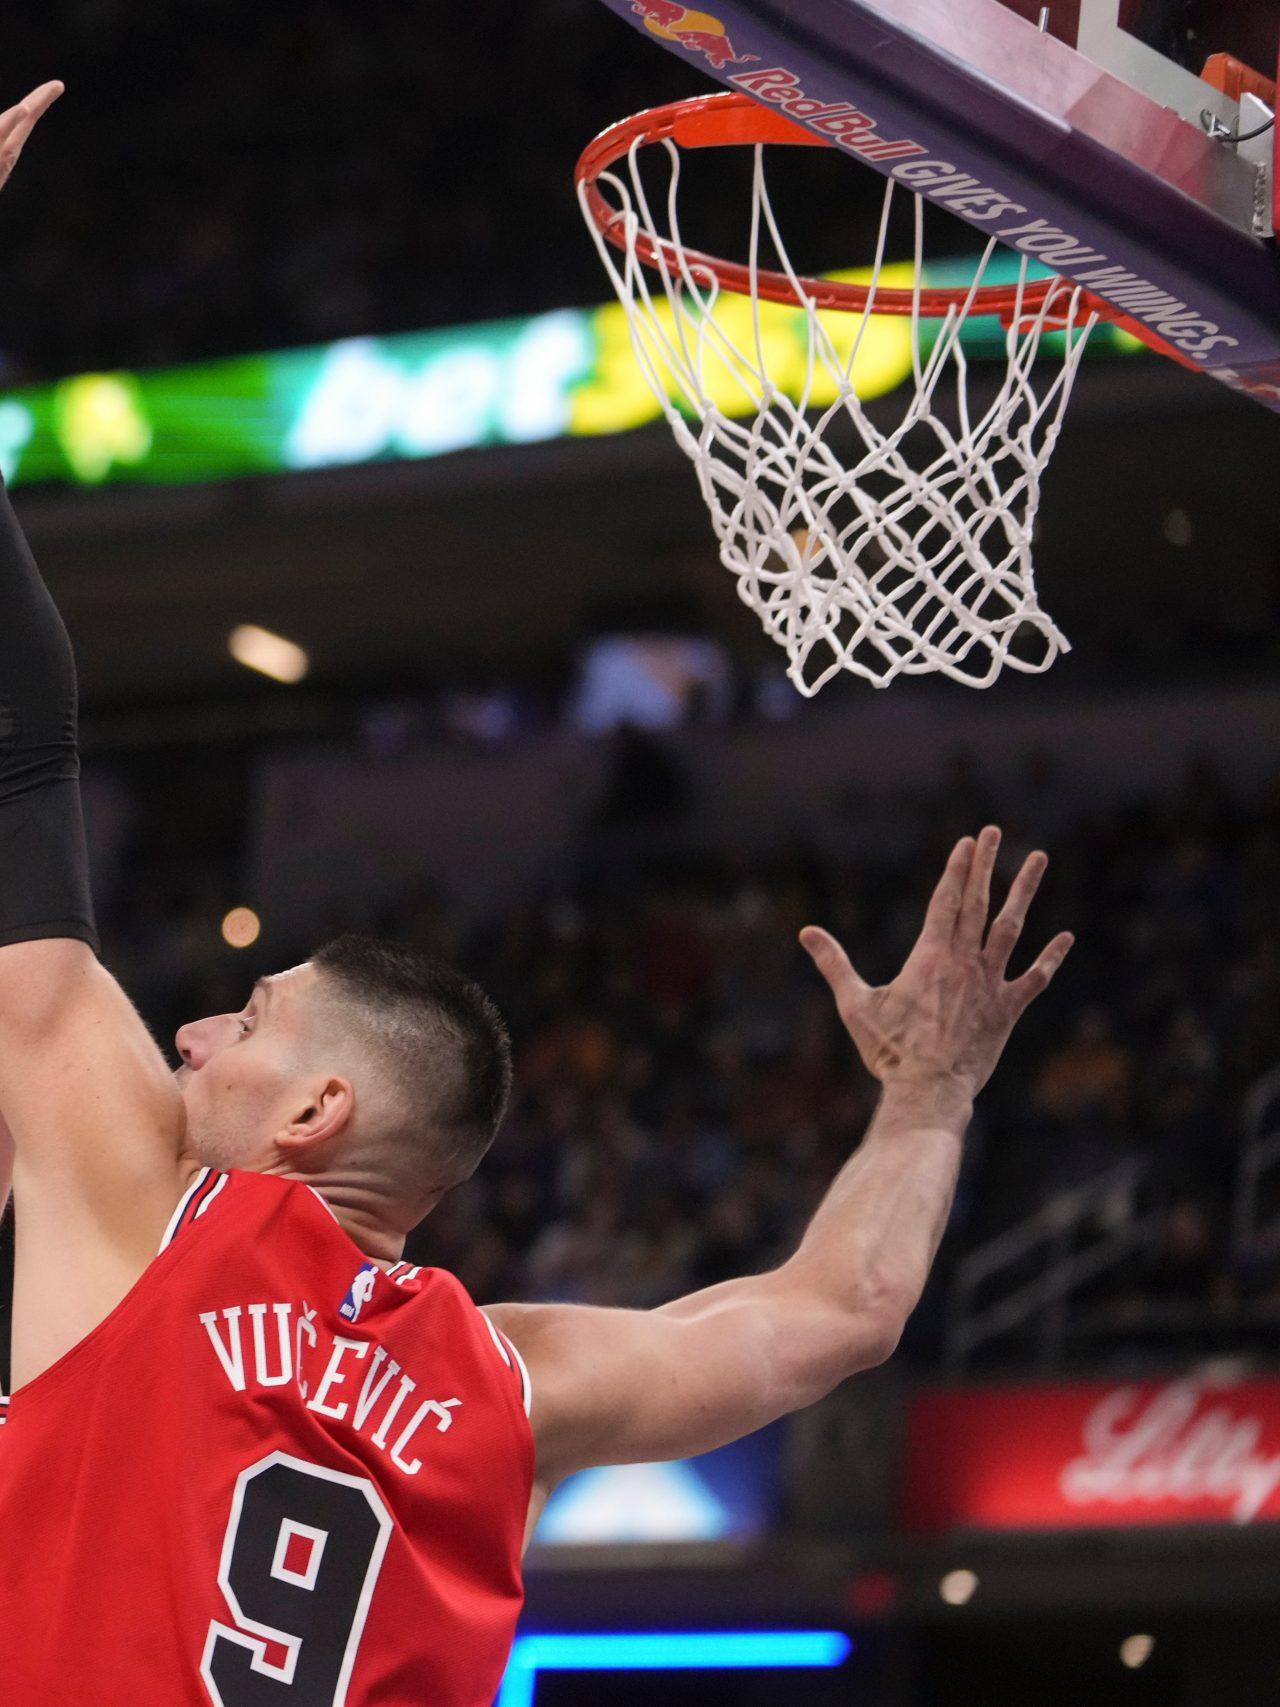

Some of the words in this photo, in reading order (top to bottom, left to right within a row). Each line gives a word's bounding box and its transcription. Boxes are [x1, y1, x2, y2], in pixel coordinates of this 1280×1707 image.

[891, 160, 1028, 221] GIVES
[994, 218, 1109, 267] YOU
[199, 1450, 394, 1707] 9
